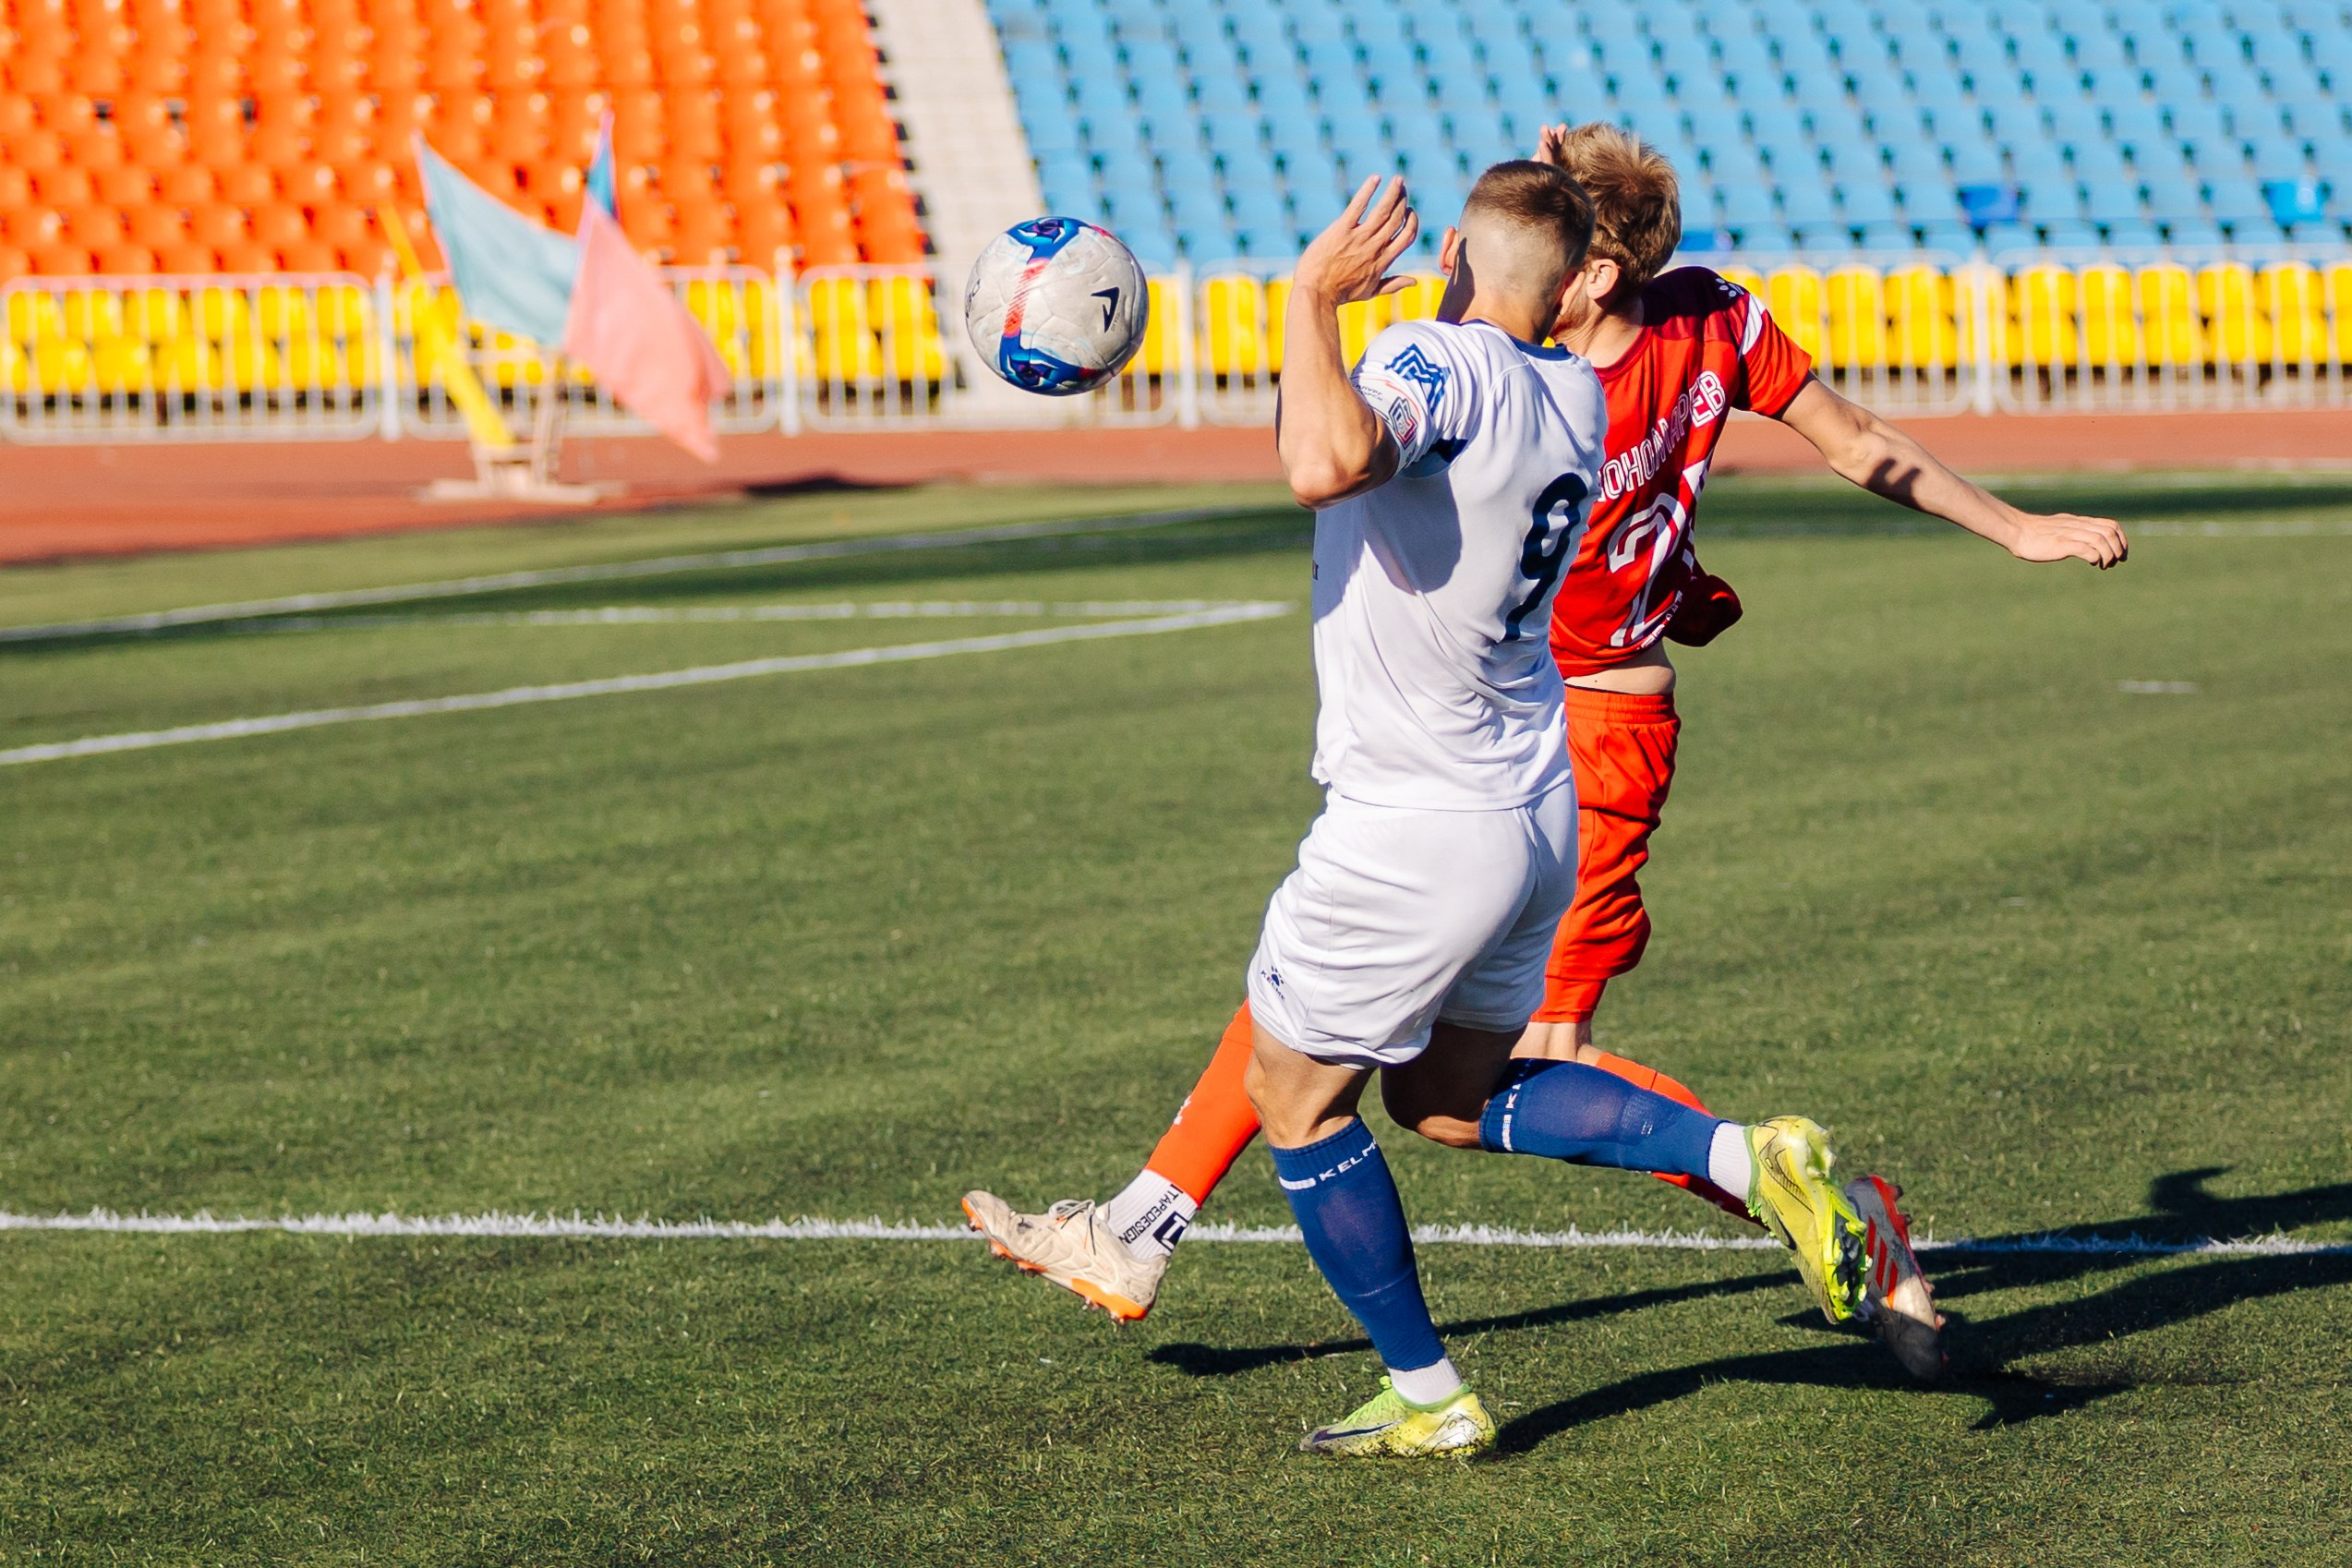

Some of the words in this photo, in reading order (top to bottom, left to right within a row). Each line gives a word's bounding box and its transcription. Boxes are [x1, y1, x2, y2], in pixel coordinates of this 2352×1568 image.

[1597, 370, 1726, 501] ОНОМАРЕВ
[1504, 472, 1588, 642] 9
[1261, 970, 1285, 1002] KELME
[1118, 1190, 1179, 1244] TAPEDESIGN
